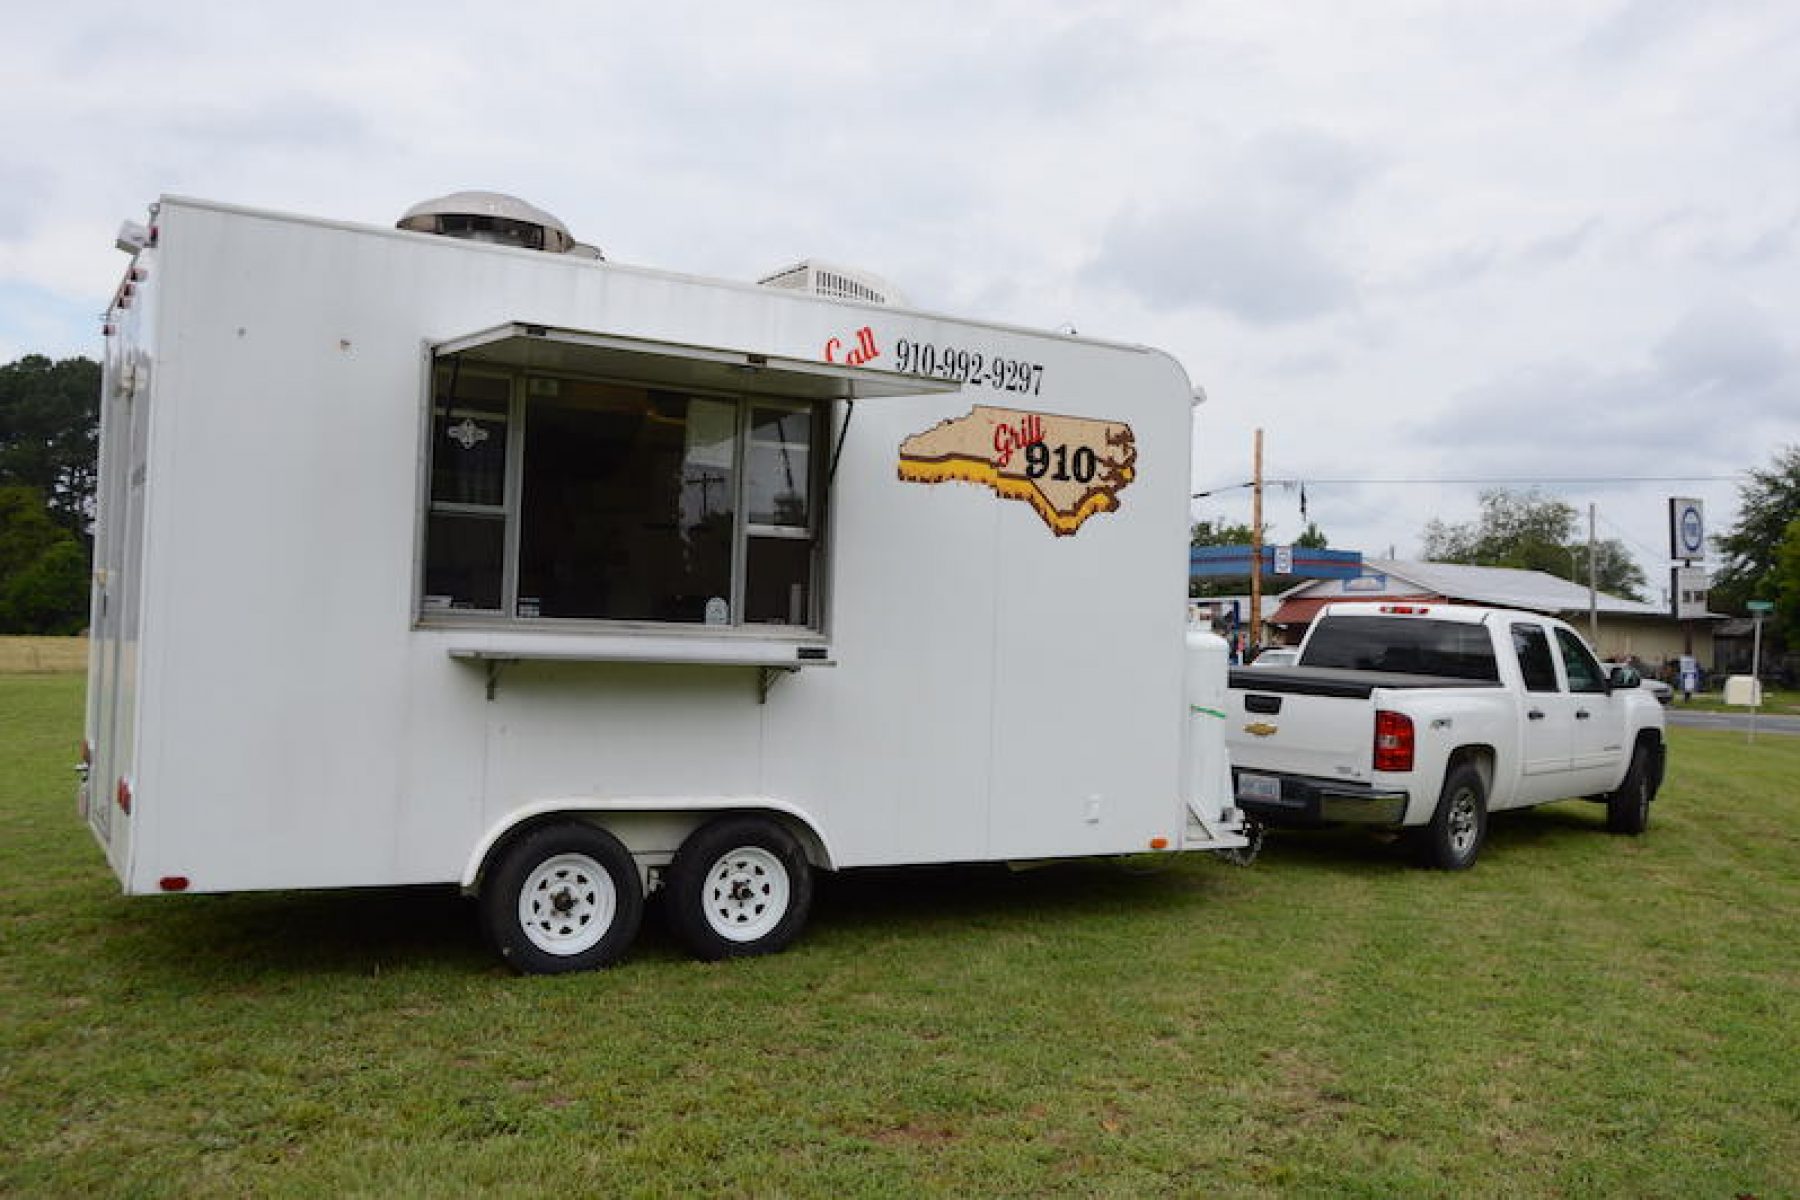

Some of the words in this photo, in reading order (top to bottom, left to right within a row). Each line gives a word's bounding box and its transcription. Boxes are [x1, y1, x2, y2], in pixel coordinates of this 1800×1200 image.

[826, 326, 880, 365] Call
[896, 339, 1043, 395] 910-992-9297
[994, 414, 1045, 467] Grill
[1026, 442, 1095, 482] 910
